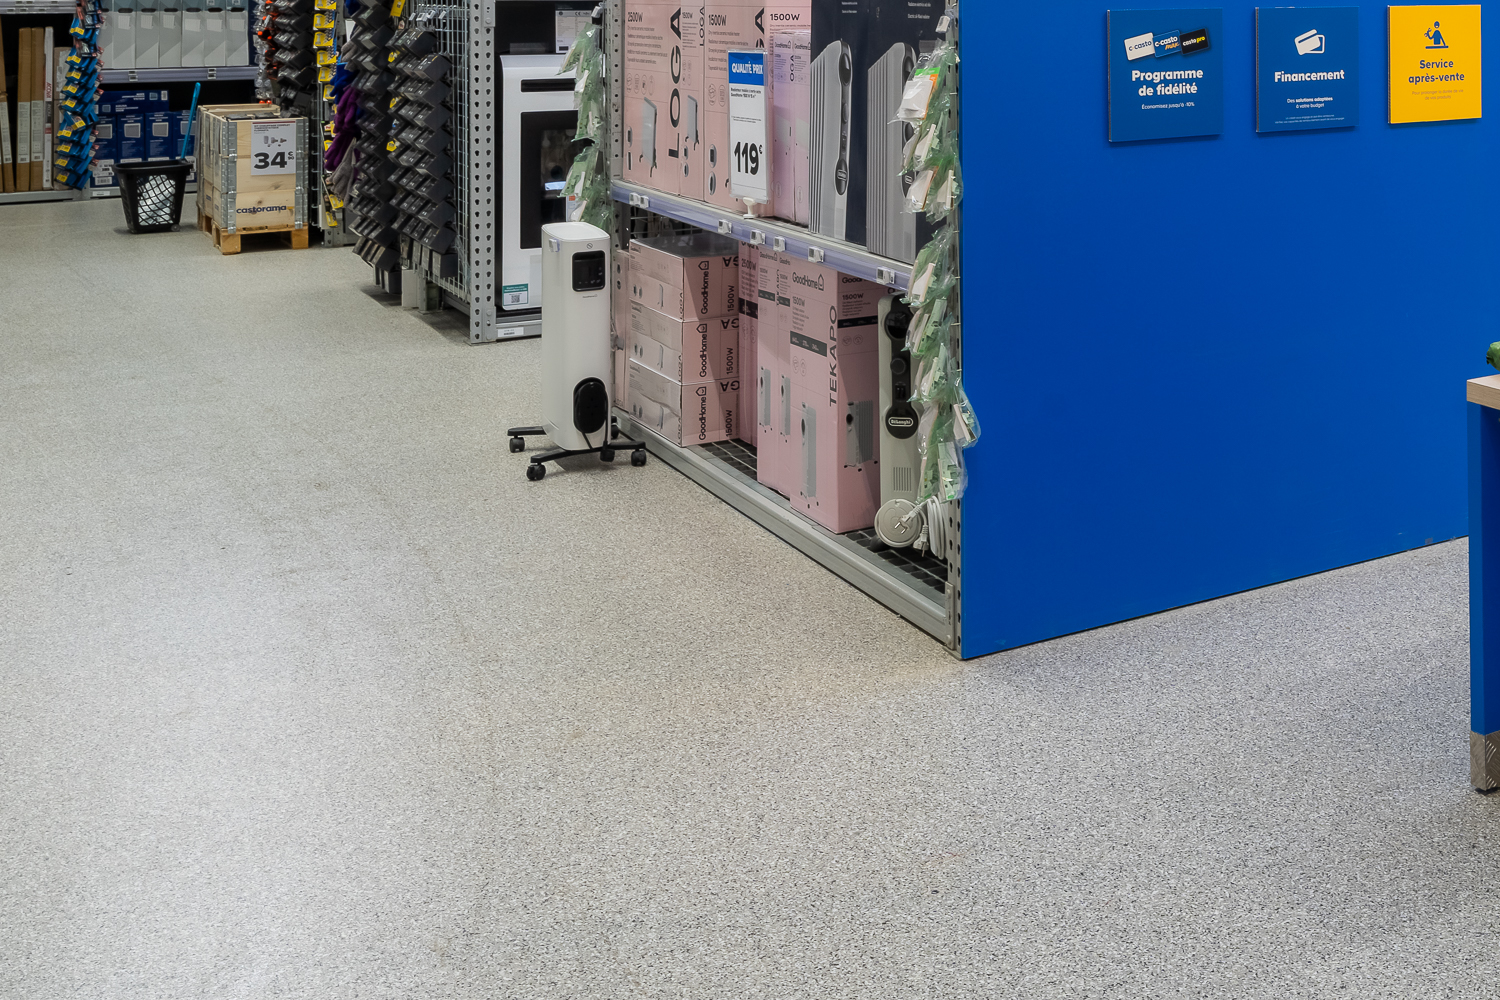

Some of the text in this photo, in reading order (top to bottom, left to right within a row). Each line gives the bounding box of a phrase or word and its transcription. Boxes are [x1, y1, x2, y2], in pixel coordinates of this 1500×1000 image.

[770, 13, 800, 21] 1500W
[732, 61, 752, 74] QUALITÉ
[1419, 59, 1454, 69] Service
[1132, 68, 1203, 84] Programme
[1274, 69, 1345, 82] Financement
[1408, 72, 1465, 85] après-vente
[1138, 82, 1197, 96] de fidélité
[254, 152, 287, 169] 34
[734, 142, 758, 175] 119
[236, 205, 286, 214] castorama
[792, 272, 818, 288] GoodHome
[701, 271, 709, 315] GoodHome
